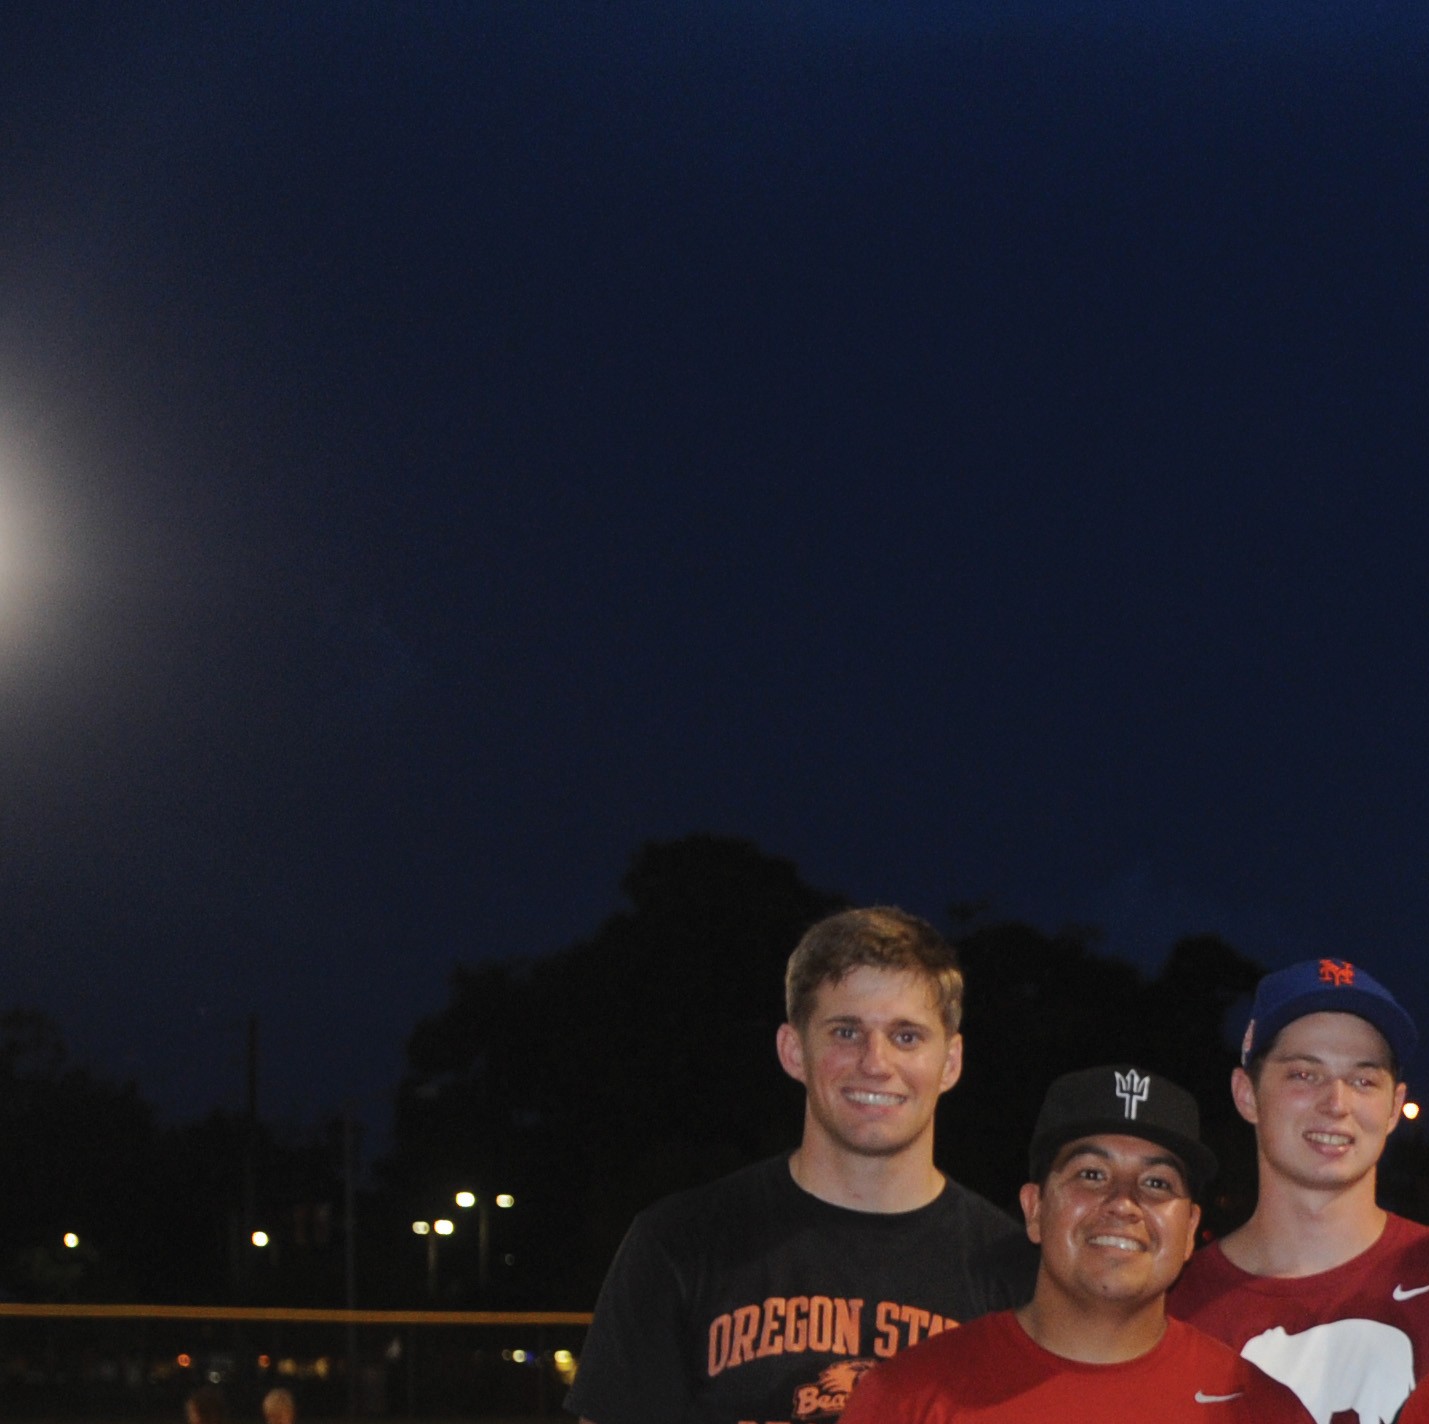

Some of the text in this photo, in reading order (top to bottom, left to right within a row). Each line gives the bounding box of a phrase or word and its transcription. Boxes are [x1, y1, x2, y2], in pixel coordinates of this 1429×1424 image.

[1319, 958, 1354, 987] NY
[707, 1296, 961, 1378] OREGON STA
